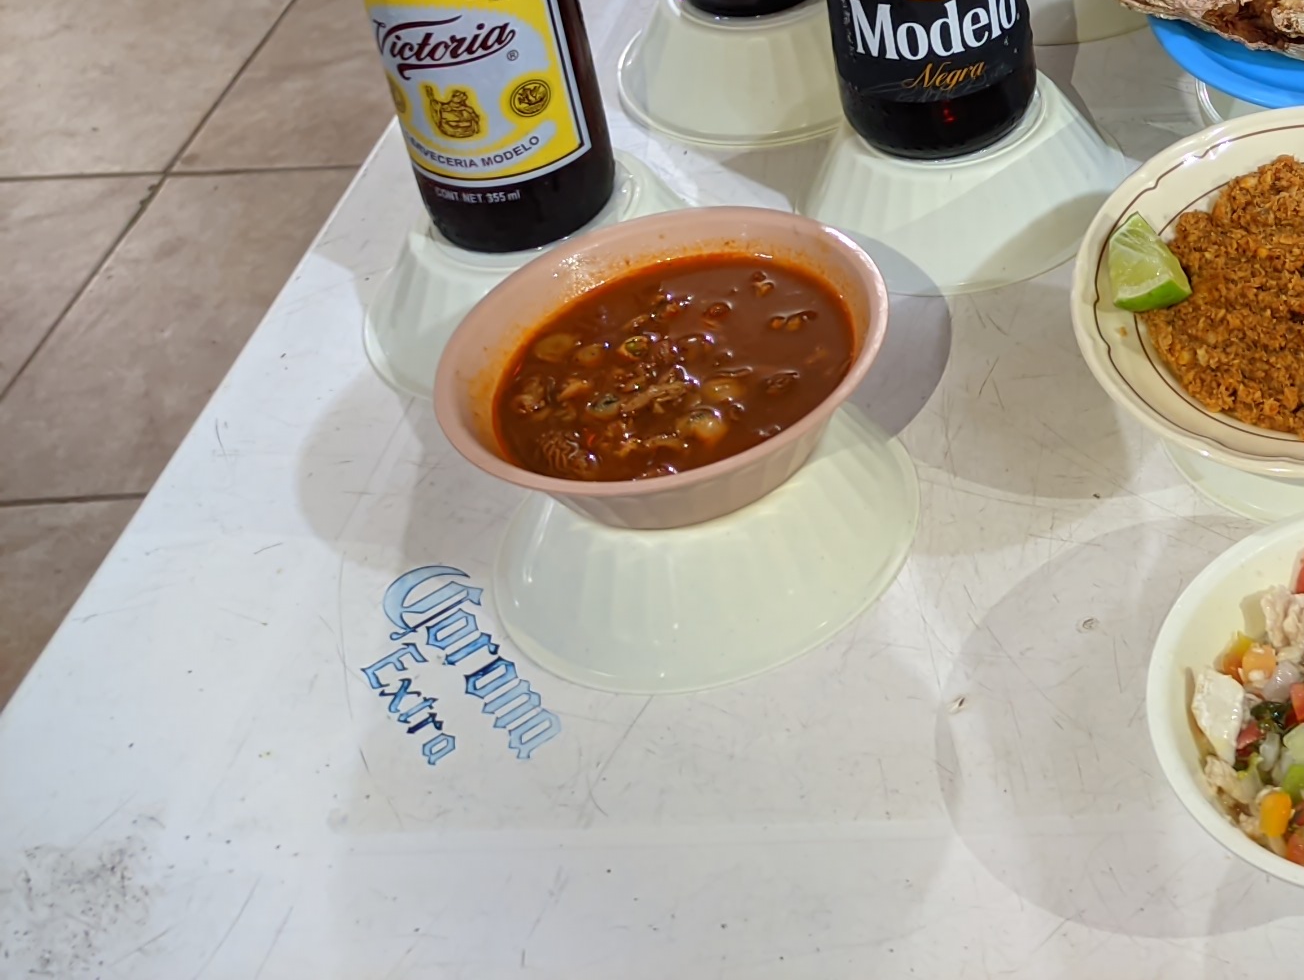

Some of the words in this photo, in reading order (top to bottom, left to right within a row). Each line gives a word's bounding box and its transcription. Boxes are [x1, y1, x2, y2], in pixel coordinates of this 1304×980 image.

[372, 15, 516, 67] Victoria
[902, 59, 986, 91] Negra
[402, 130, 479, 168] ERVECERIA
[481, 135, 540, 166] MODELO
[462, 192, 483, 203] NET
[485, 191, 506, 203] 355
[508, 189, 521, 200] ml
[383, 565, 562, 759] Corona
[360, 642, 456, 765] Extra
